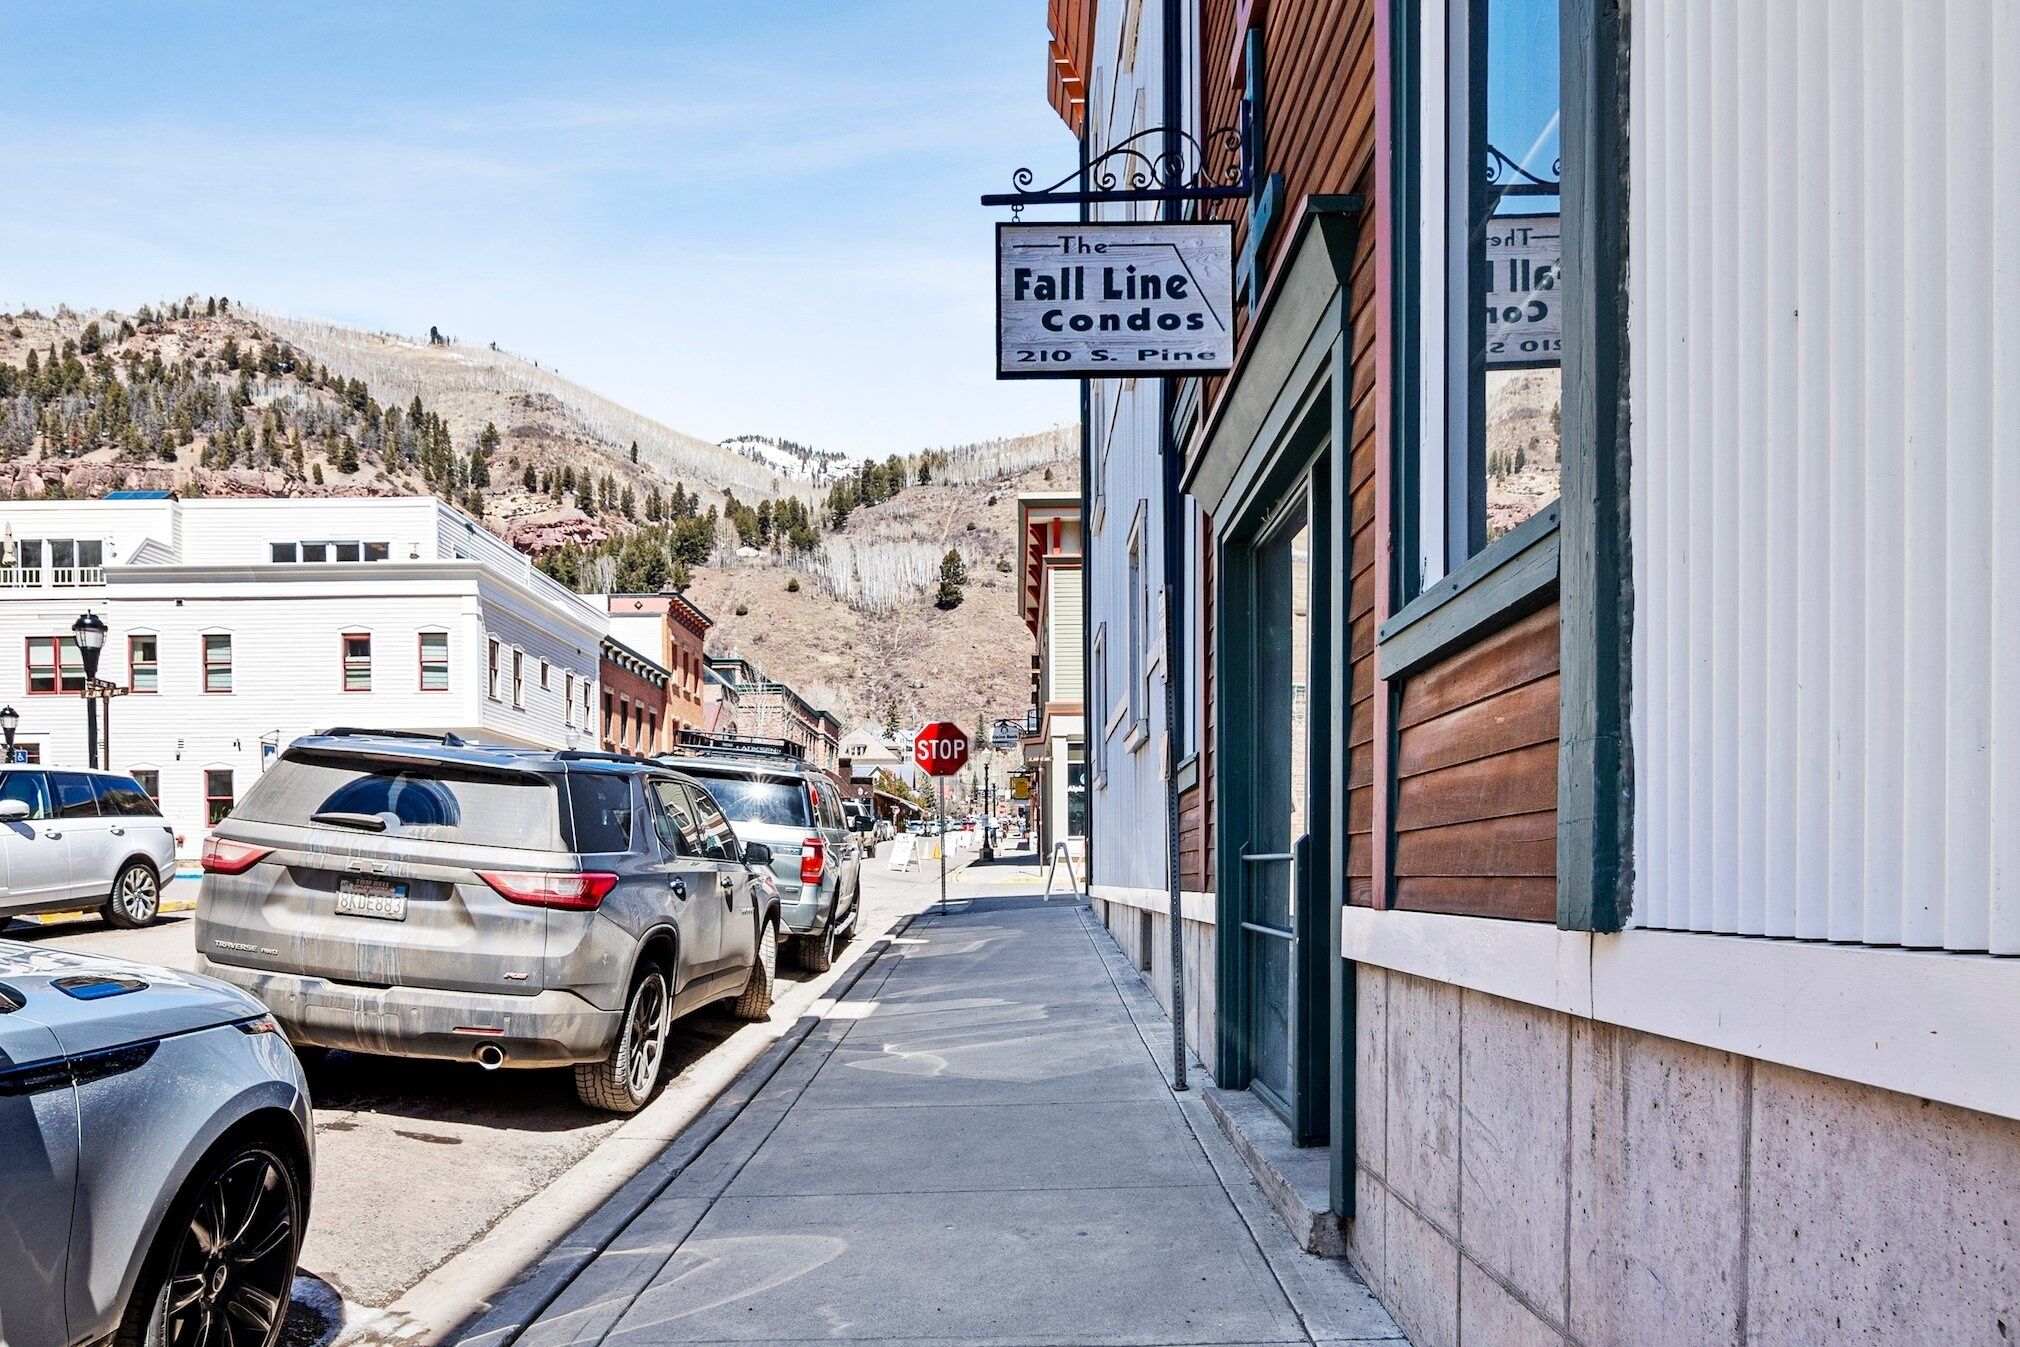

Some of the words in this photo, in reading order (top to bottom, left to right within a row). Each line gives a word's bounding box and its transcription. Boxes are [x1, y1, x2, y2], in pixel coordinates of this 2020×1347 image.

[1058, 236, 1108, 254] The
[1014, 265, 1084, 301] Fall
[1103, 264, 1189, 300] Line
[1041, 307, 1204, 332] Condos
[1016, 350, 1072, 362] 210
[1091, 349, 1118, 362] S.
[1138, 349, 1216, 361] Pine
[917, 739, 966, 761] STOP
[340, 890, 402, 914] 8KDE883
[214, 939, 258, 953] TRAVERSE
[260, 946, 279, 956] AWD
